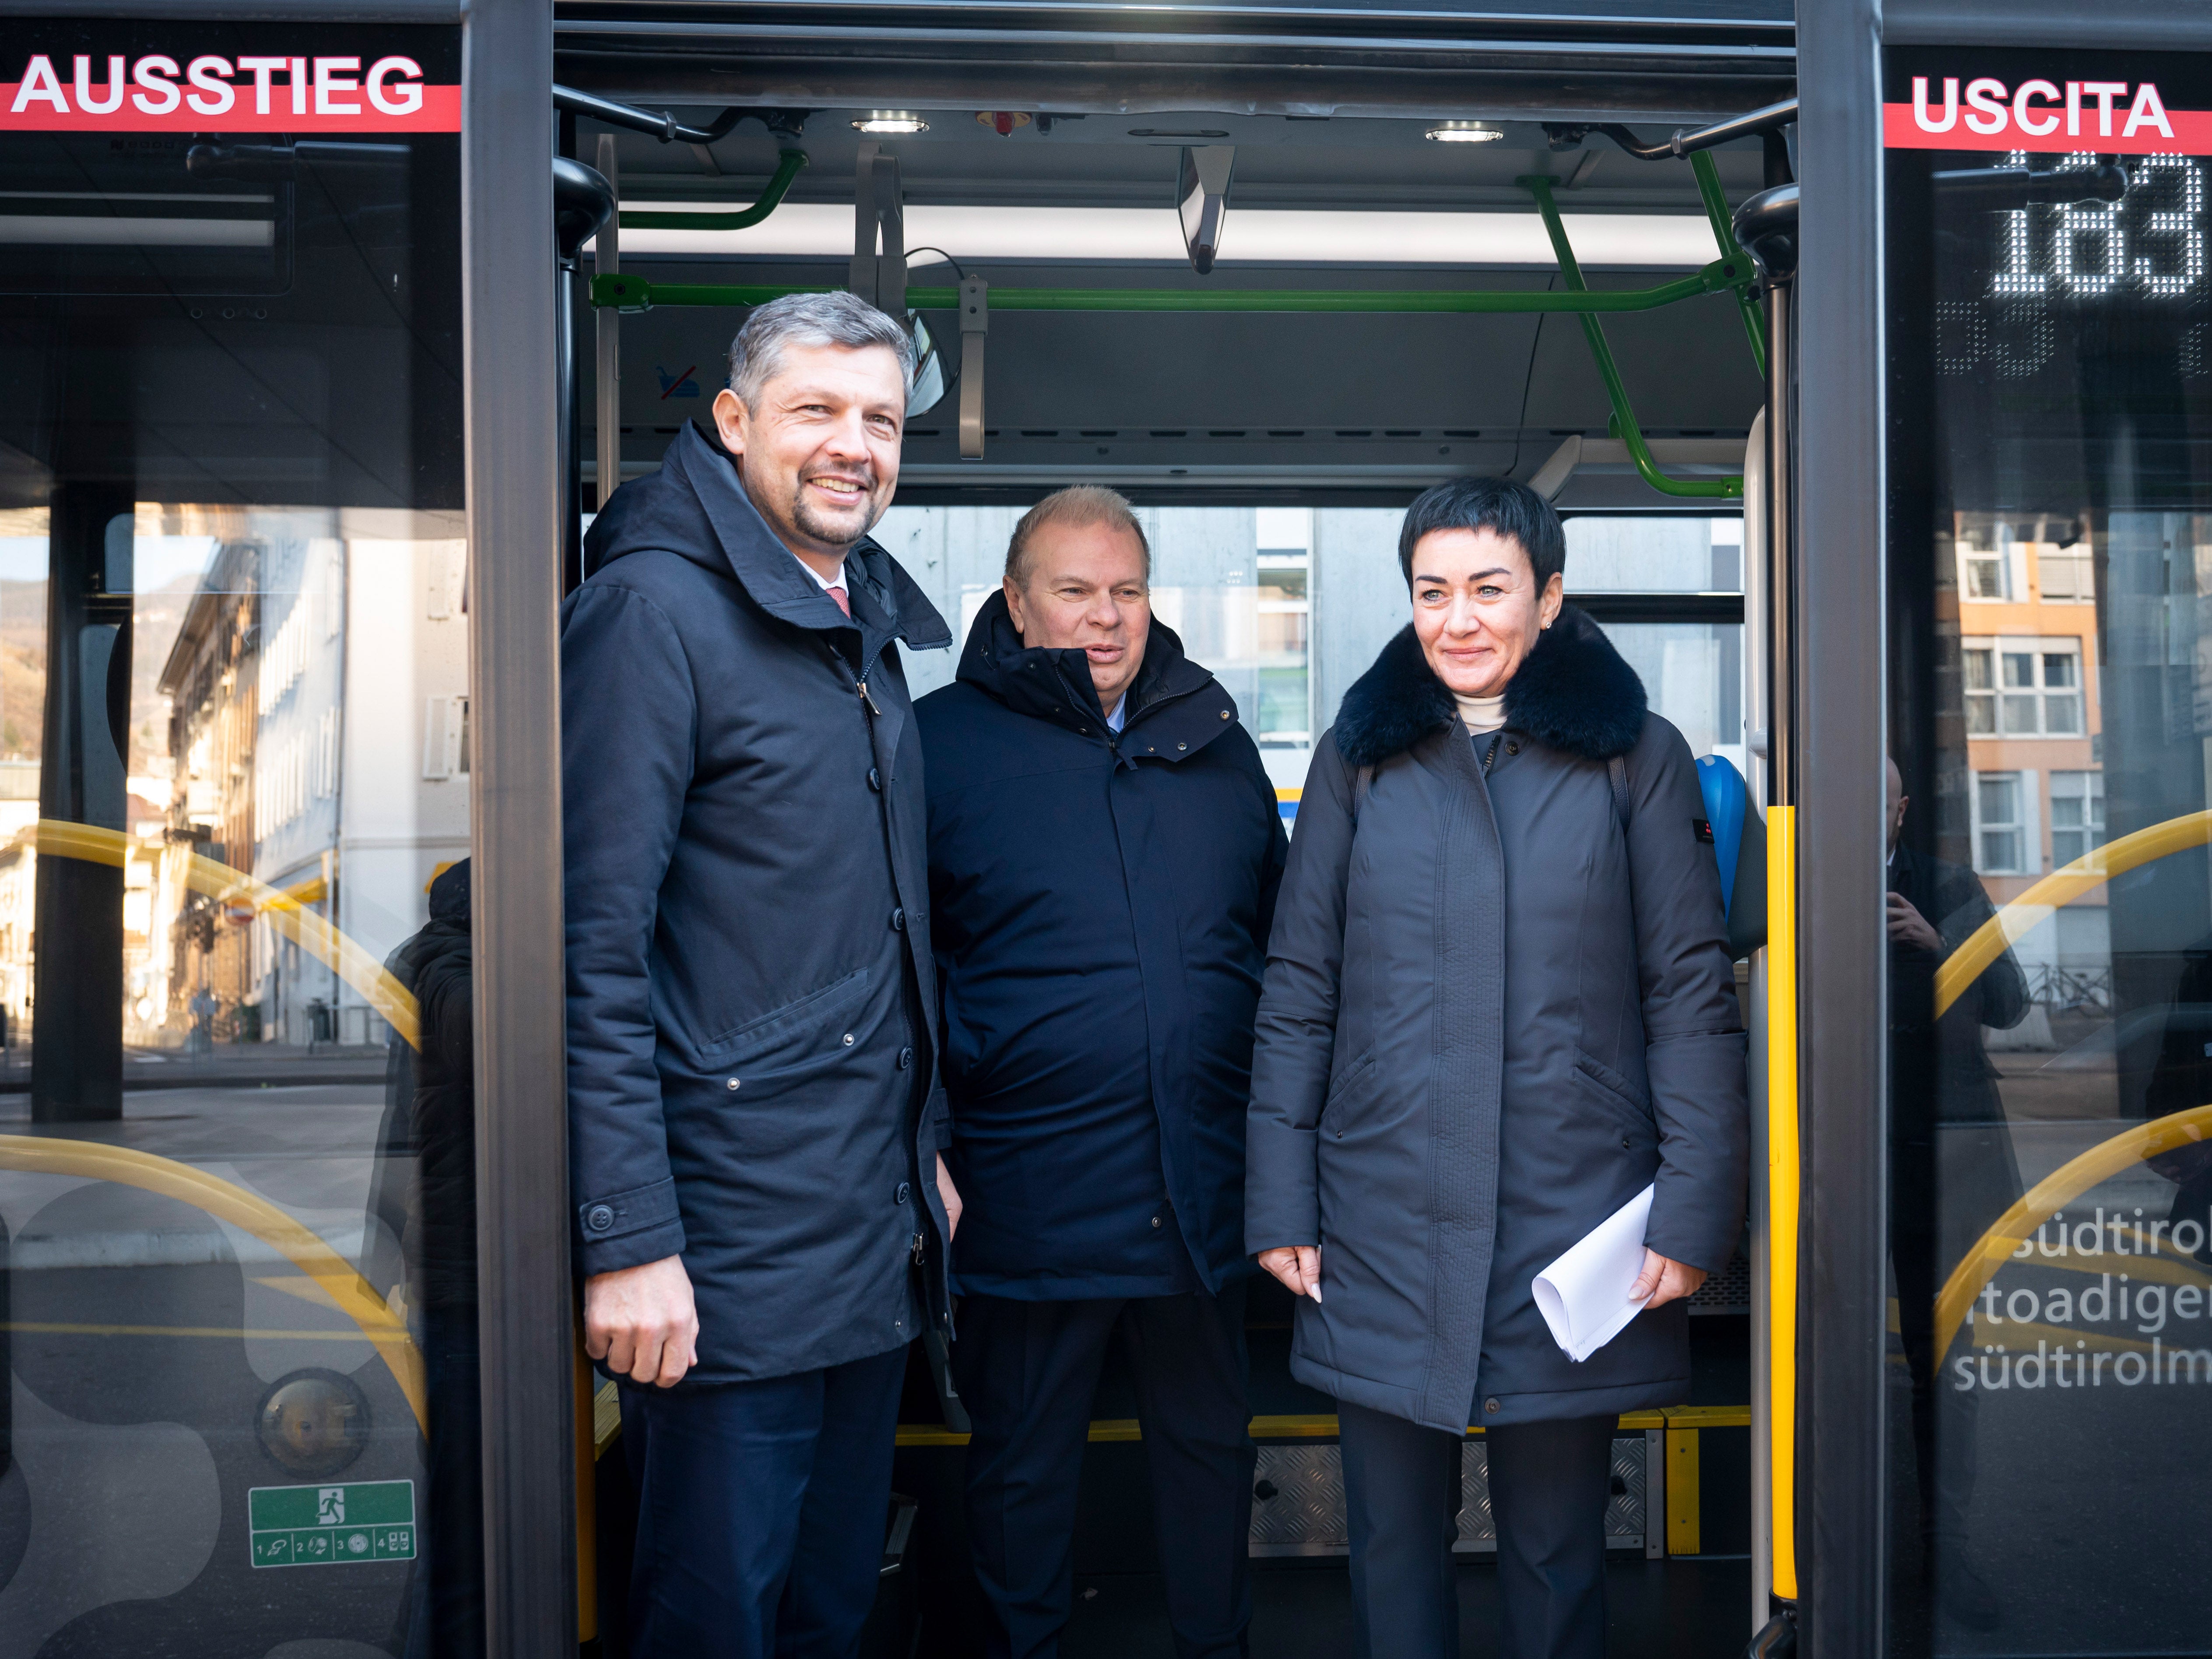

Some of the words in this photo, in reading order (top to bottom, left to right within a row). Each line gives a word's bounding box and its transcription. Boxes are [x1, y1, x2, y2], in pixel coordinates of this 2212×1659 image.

[11, 55, 423, 116] AUSSTIEG
[1913, 77, 2175, 138] USCITA
[1993, 149, 2203, 293] 183
[1954, 1337, 2212, 1391] südtirolm
[256, 1545, 262, 1554] 1
[296, 1542, 304, 1552] 2
[337, 1540, 344, 1550] 3
[377, 1538, 385, 1548] 4
